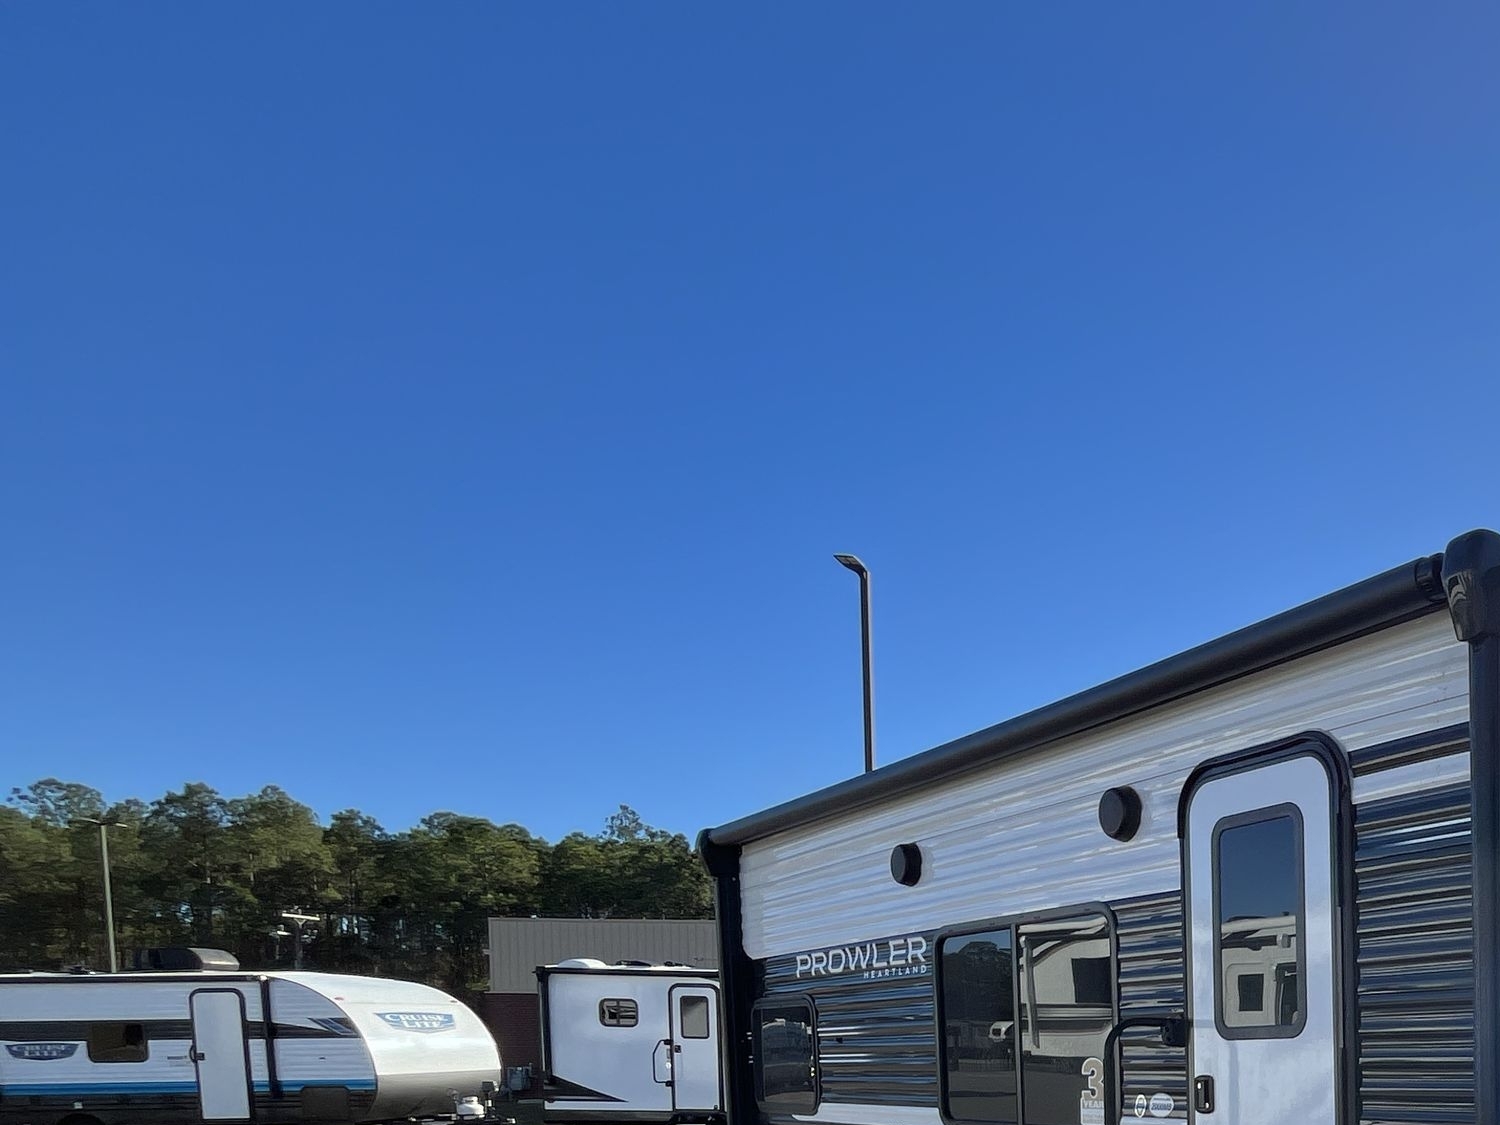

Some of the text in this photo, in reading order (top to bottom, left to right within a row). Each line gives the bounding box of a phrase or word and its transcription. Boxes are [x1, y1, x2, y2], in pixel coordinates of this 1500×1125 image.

[796, 936, 927, 979] PROWLER
[863, 965, 927, 979] HEARTLAND
[1081, 1057, 1104, 1099] 3
